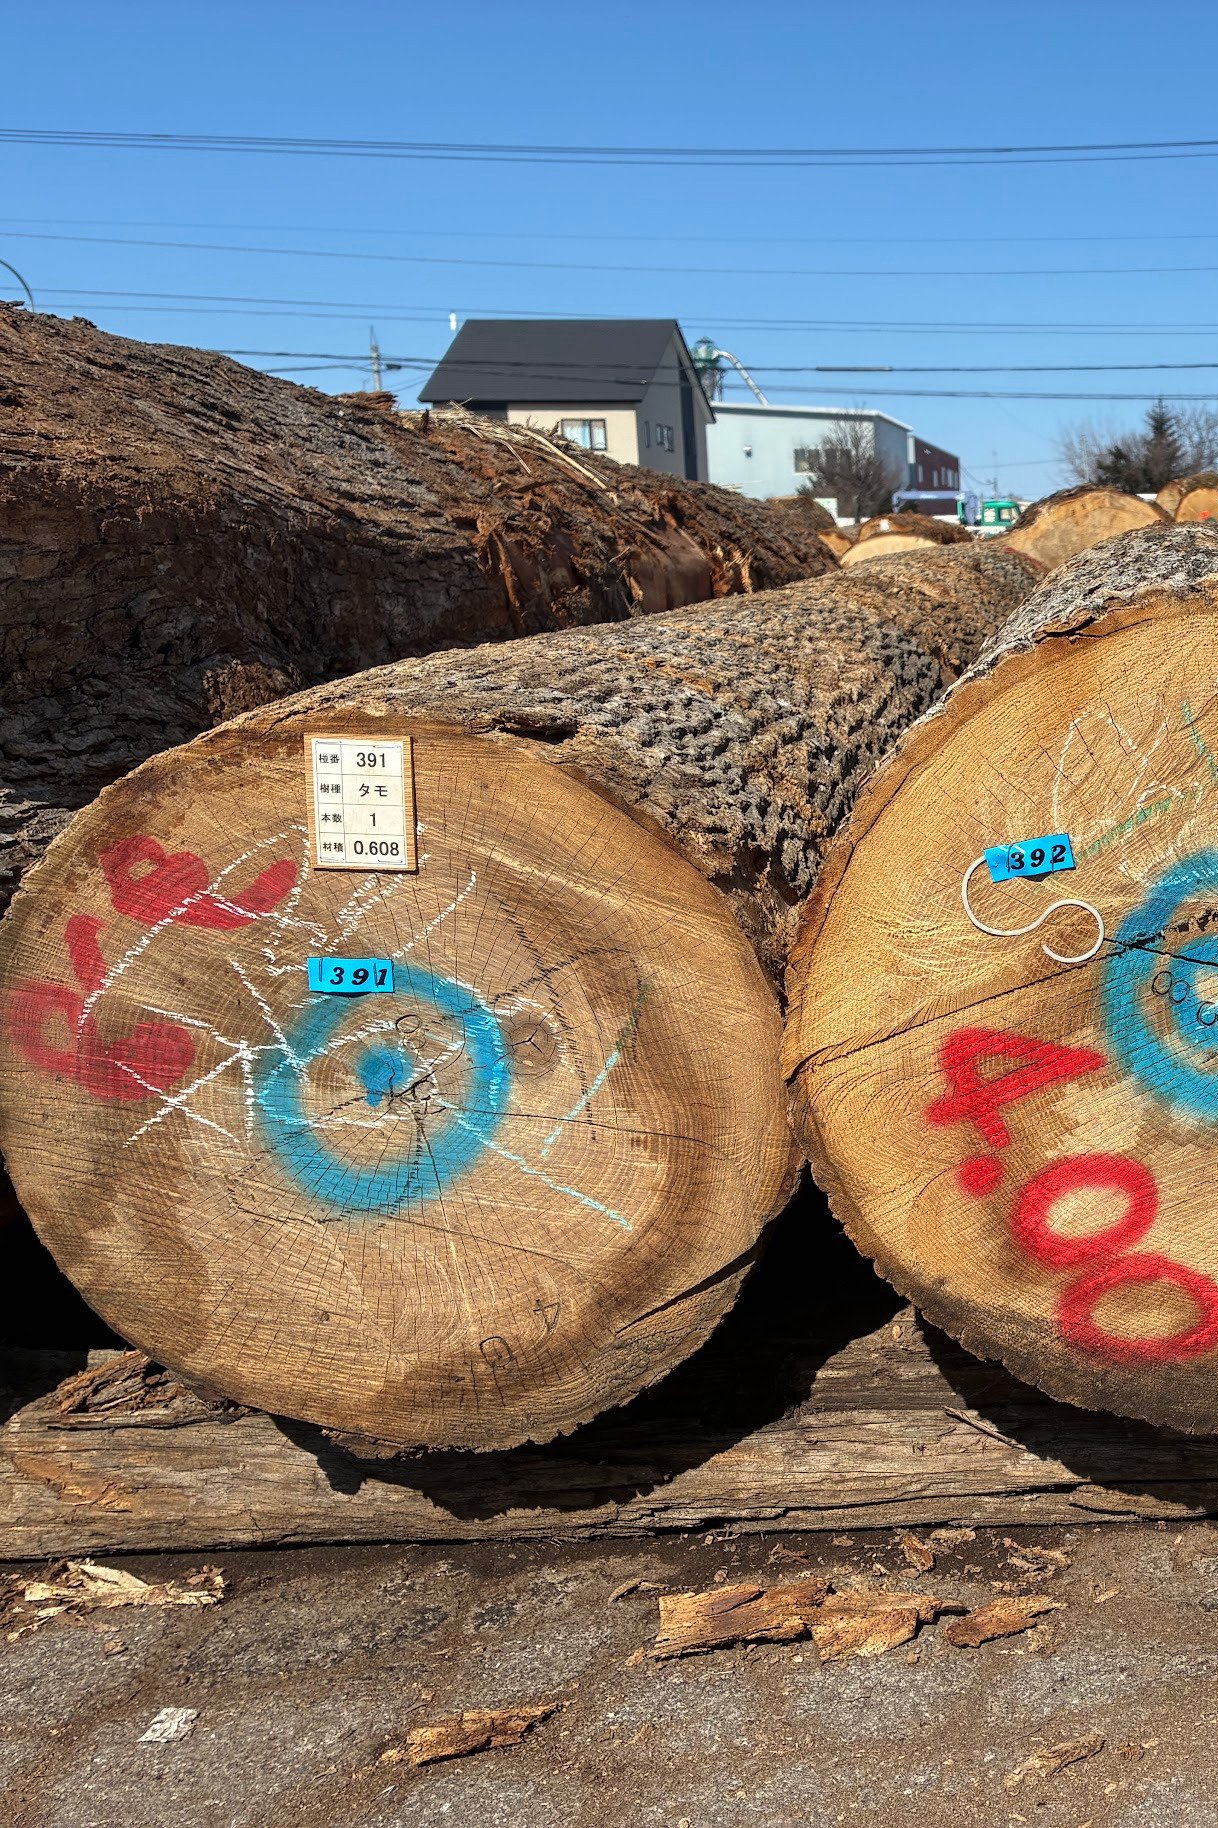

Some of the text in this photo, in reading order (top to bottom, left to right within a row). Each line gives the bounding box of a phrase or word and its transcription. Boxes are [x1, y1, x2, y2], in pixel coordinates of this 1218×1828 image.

[356, 752, 386, 768] 391
[320, 783, 388, 798] 樹種 タモ
[321, 813, 376, 827] 本数 1
[322, 840, 400, 856] 材積 0.608
[1010, 844, 1067, 870] 392
[329, 966, 388, 986] 391
